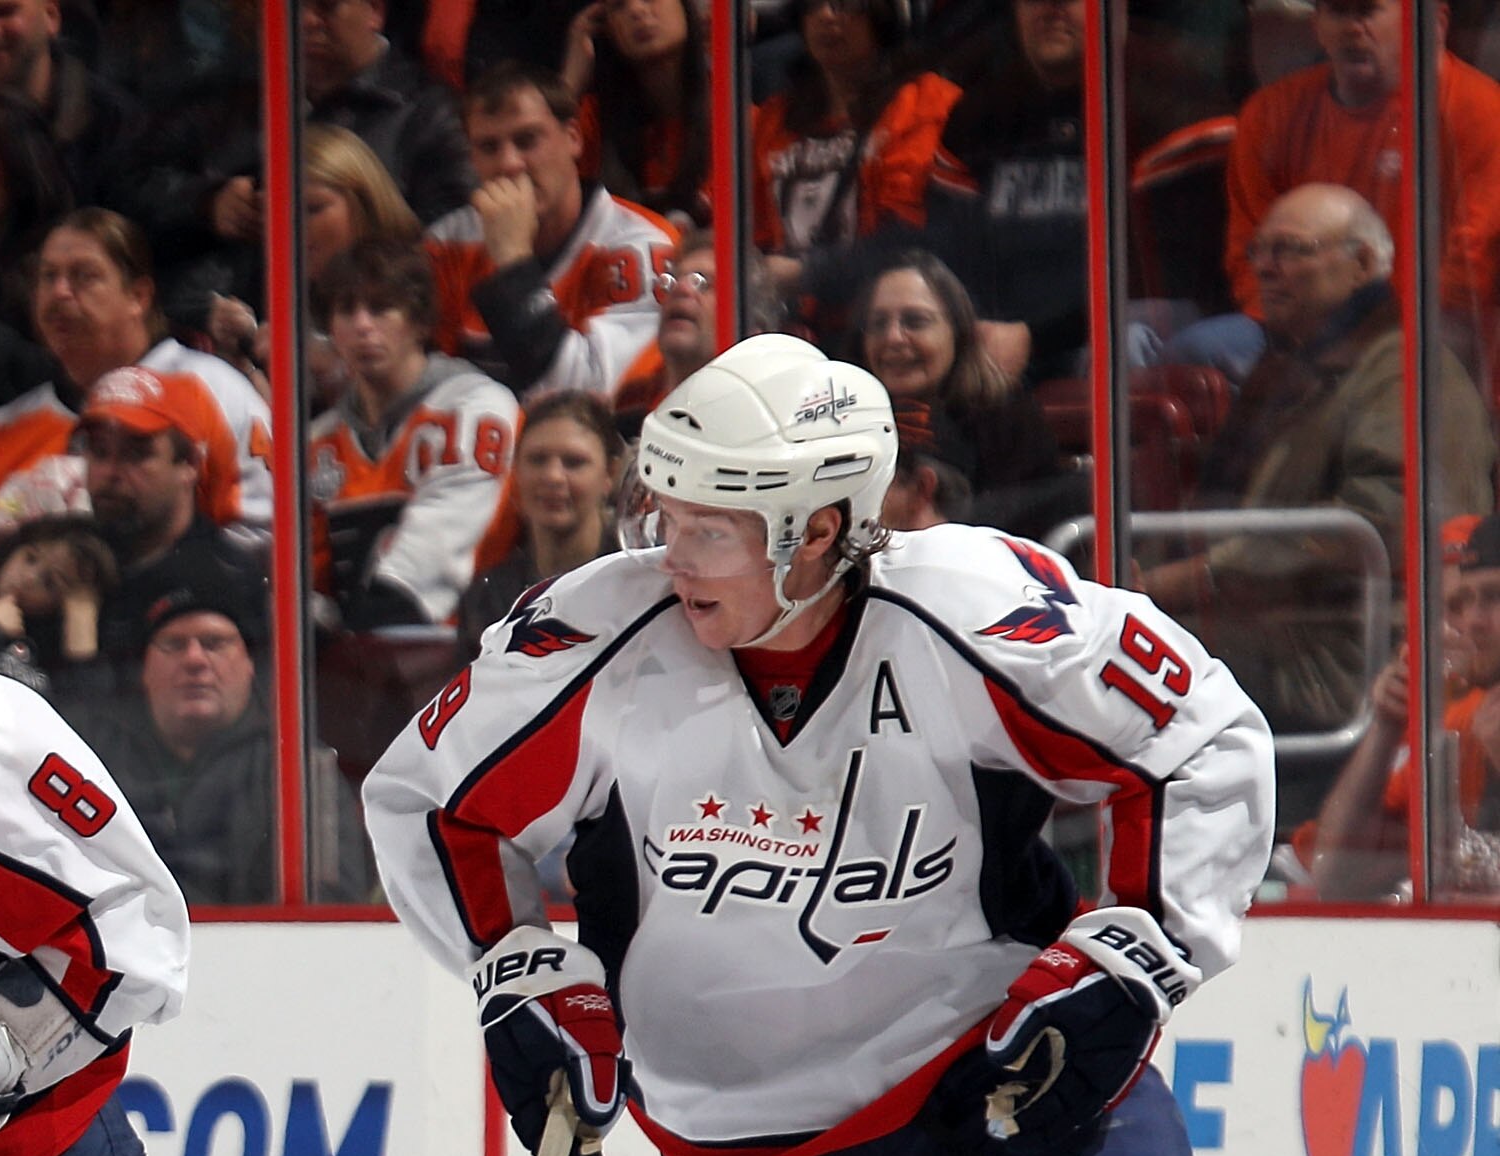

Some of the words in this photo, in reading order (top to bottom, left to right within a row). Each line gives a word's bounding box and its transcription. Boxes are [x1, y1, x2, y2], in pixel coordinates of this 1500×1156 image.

[870, 659, 913, 735] A
[1098, 612, 1192, 731] 19
[27, 751, 118, 838] 8
[643, 745, 957, 966] capitals
[669, 828, 820, 857] WASHINGTON
